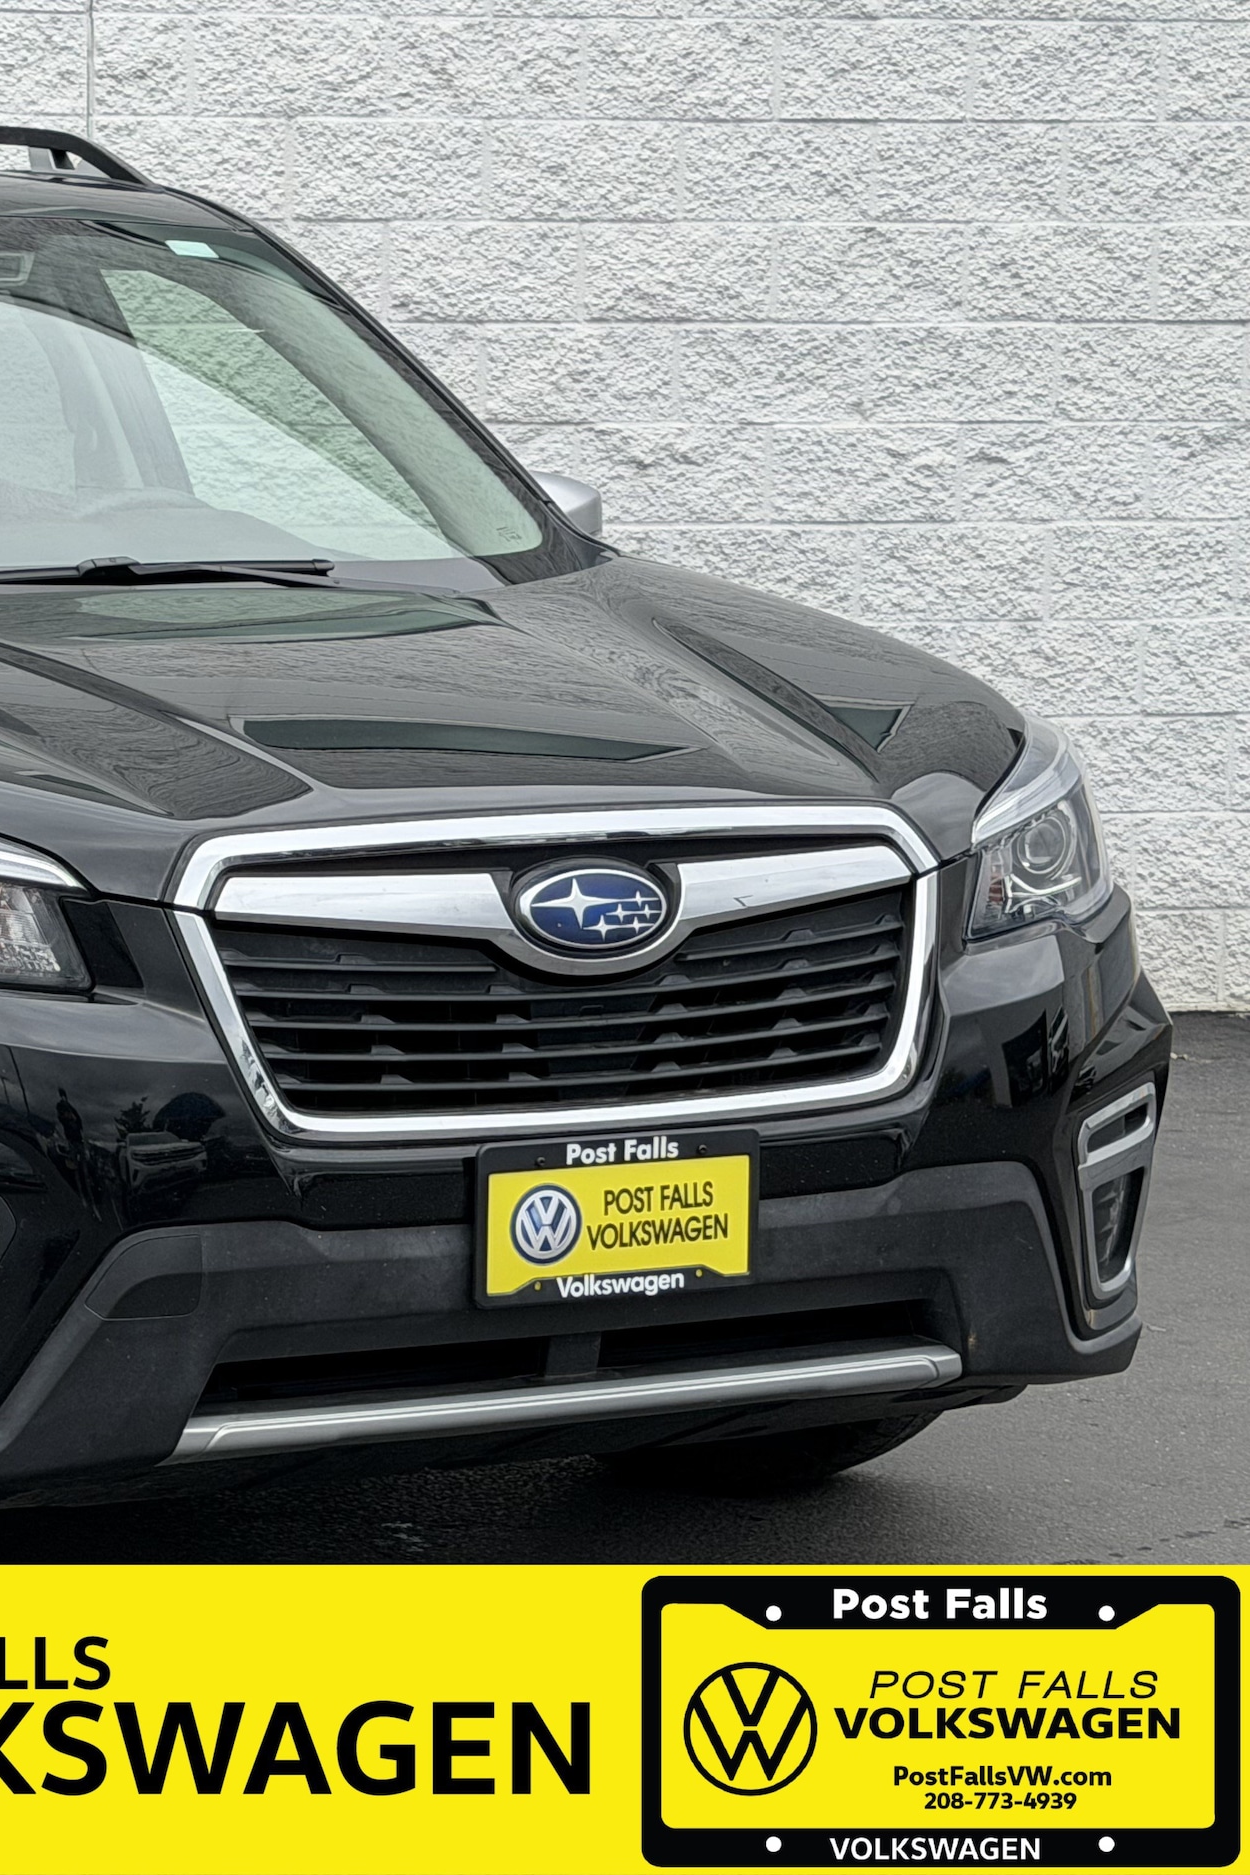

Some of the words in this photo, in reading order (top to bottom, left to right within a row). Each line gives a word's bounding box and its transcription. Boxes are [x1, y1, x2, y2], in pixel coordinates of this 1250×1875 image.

[566, 1142, 616, 1166] Post
[623, 1136, 679, 1161] Falls
[603, 1186, 654, 1216] POST
[660, 1181, 714, 1211] FALLS
[586, 1213, 729, 1251] VOLKSWAGEN
[556, 1272, 685, 1298] Volkswagen
